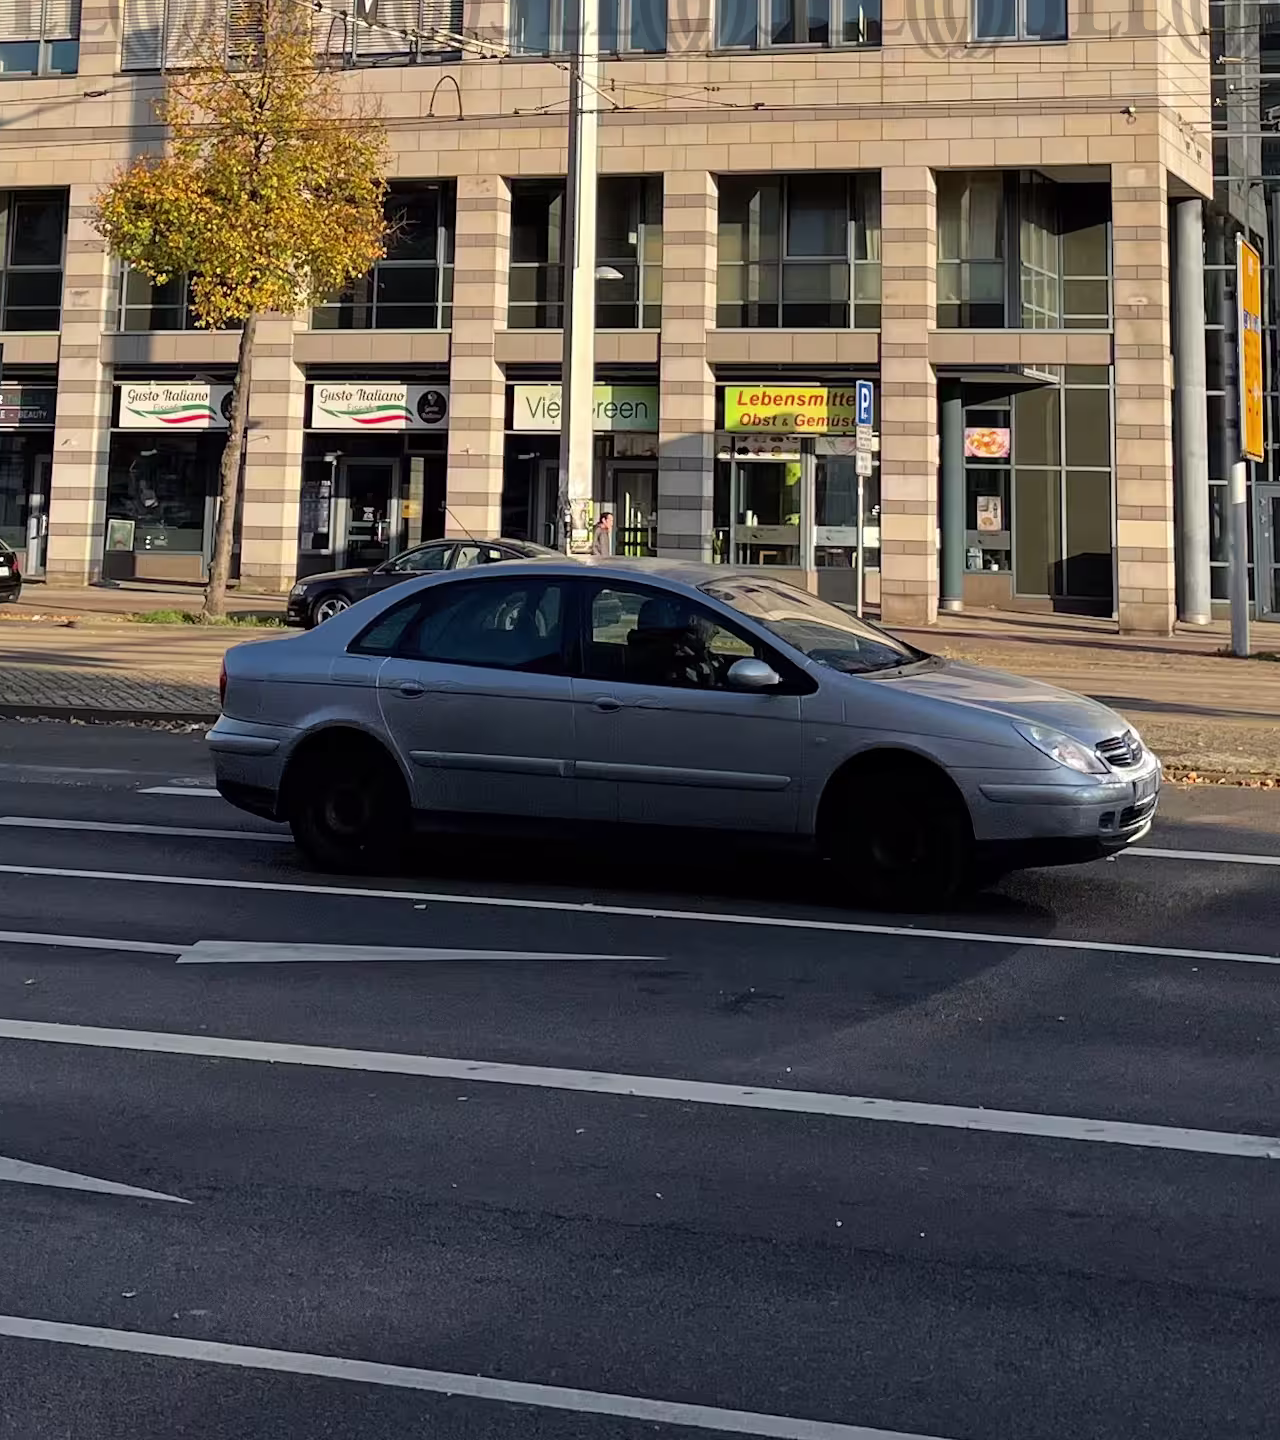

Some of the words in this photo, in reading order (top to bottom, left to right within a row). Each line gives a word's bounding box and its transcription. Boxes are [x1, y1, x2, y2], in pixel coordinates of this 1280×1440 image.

[127, 389, 160, 404] Gusto
[162, 389, 208, 402] Italiano
[320, 388, 353, 403] Gusto
[356, 388, 405, 402] Italiano
[737, 390, 856, 407] Lebensmitte
[860, 387, 870, 420] P
[592, 401, 648, 419] reen
[739, 412, 777, 426] Obst
[782, 417, 789, 426] &
